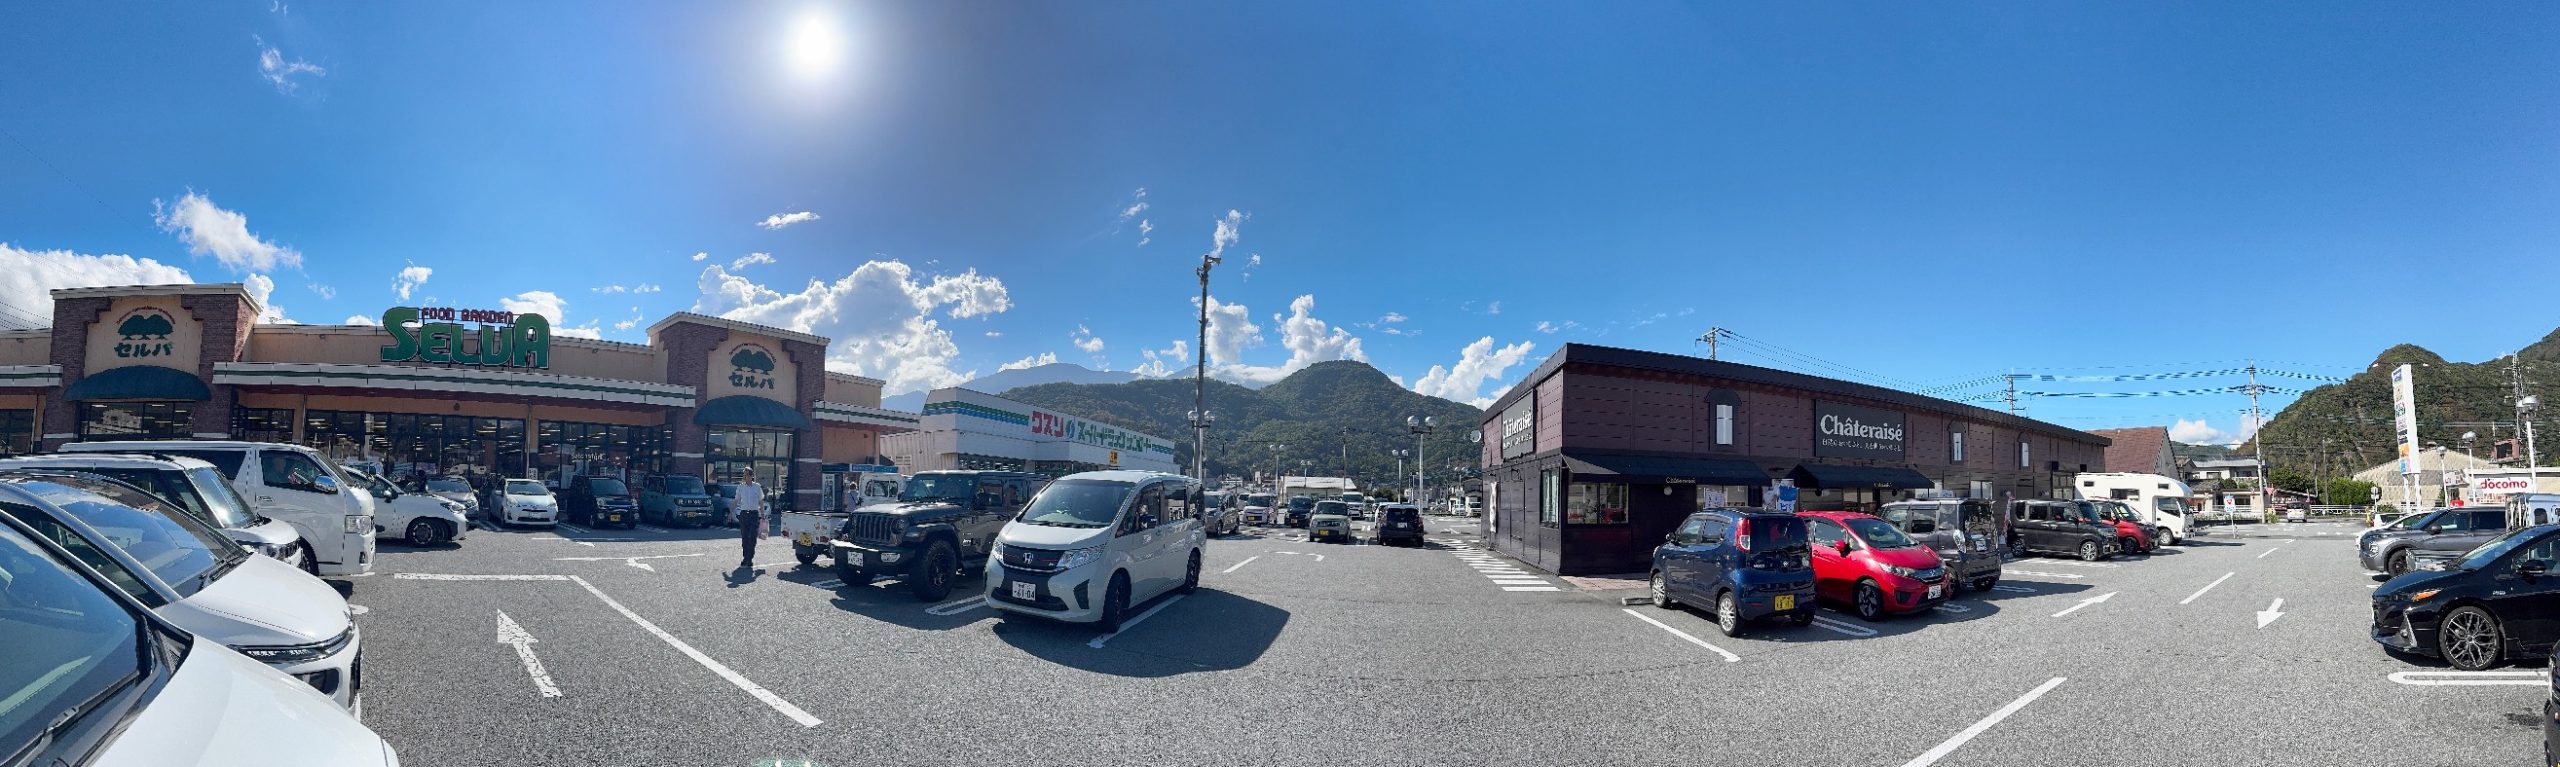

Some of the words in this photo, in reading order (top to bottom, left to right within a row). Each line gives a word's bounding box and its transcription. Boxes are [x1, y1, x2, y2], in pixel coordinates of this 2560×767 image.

[422, 307, 456, 320] FOOD
[461, 308, 514, 324] GARDEN
[1820, 414, 1903, 442] Châteraisé
[2480, 478, 2528, 490] docomo
